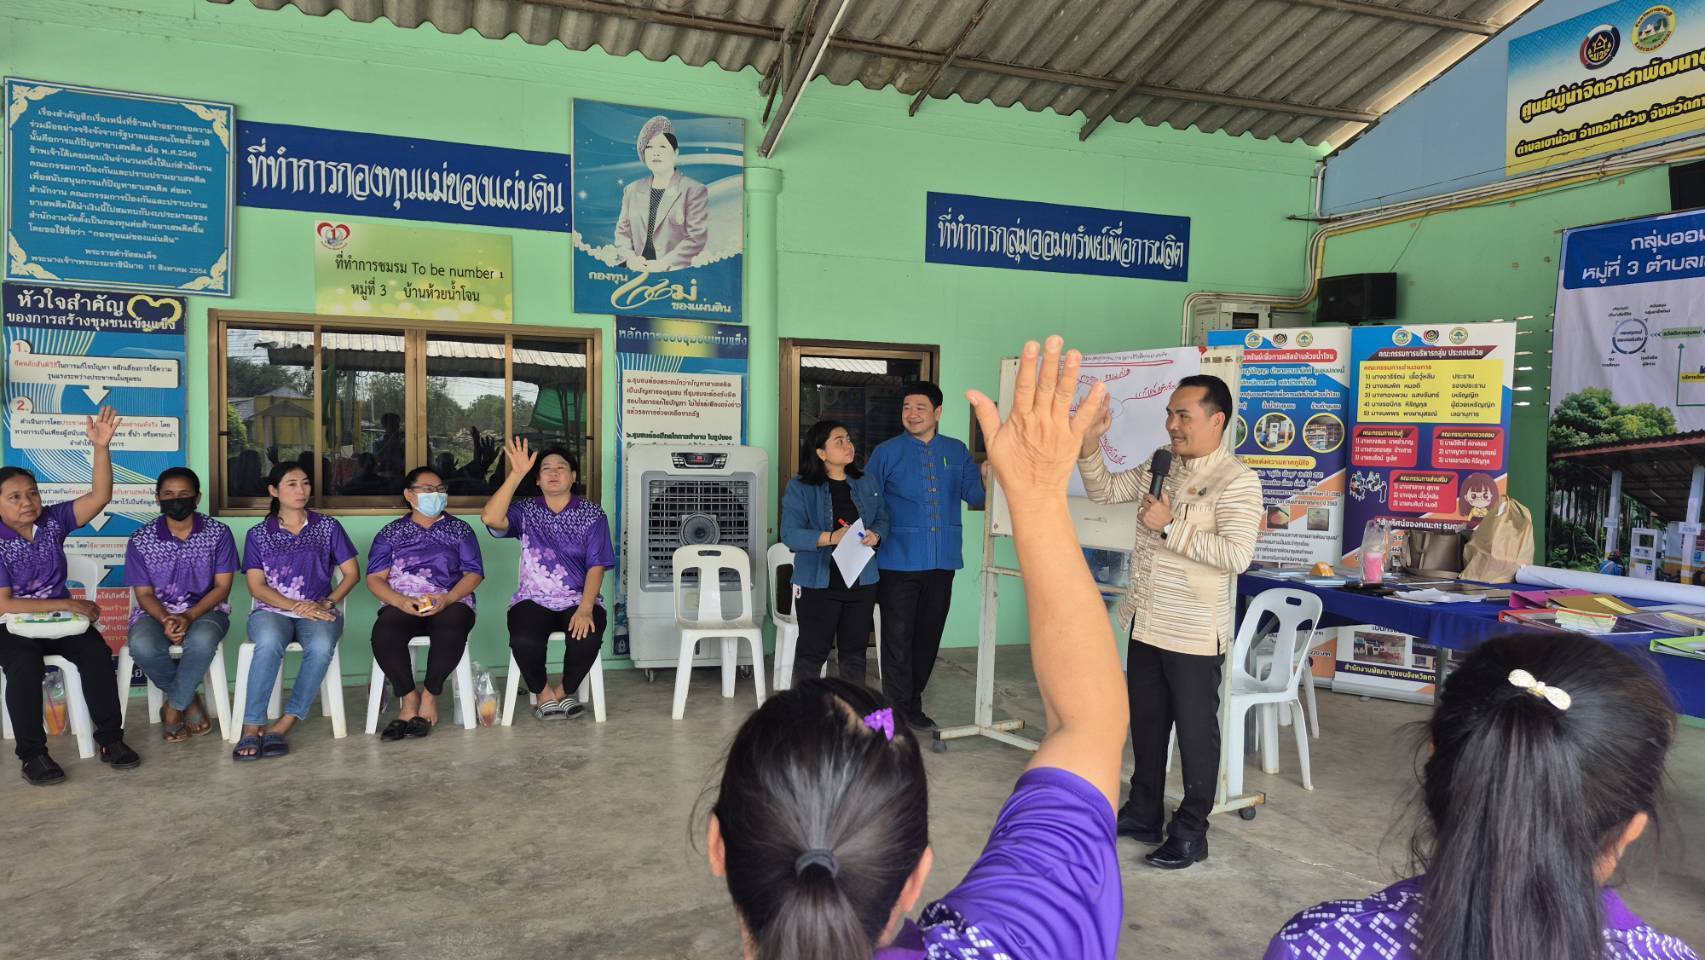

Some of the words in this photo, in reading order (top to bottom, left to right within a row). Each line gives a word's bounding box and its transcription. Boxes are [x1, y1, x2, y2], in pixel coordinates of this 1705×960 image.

[247, 138, 564, 215] ที่ทำการกองทุนแม่ของแผ่นดิน
[29, 184, 67, 196] สำนักงาน
[938, 208, 1184, 271] ที่ทำการกลุ่มออมทรัพย์เพื่อการผลิต
[334, 251, 407, 275] ที่ทำการชมรม
[411, 262, 427, 276] To
[429, 263, 446, 277] be
[449, 265, 495, 280] number
[1582, 254, 1621, 285] หมู่ที่
[1626, 260, 1640, 276] 3
[1646, 254, 1705, 274] ตำบลเ
[588, 271, 629, 285] กองทุน
[351, 278, 376, 302] หมู่ที่
[379, 284, 388, 298] 3
[403, 280, 481, 303] บ้านห้วยน้ำโจน
[17, 287, 124, 317] หัวใจสำคัญ
[671, 297, 731, 314] ของแผ่นดิน
[6, 311, 176, 331] ของการสร้างชุมชนเข้มแข็ง
[1378, 348, 1447, 358] คณะกรรมการบริหารกลุ่ม
[1344, 664, 1436, 682] สำนักงานพัฒนาชุมชนจังหวัดกา
